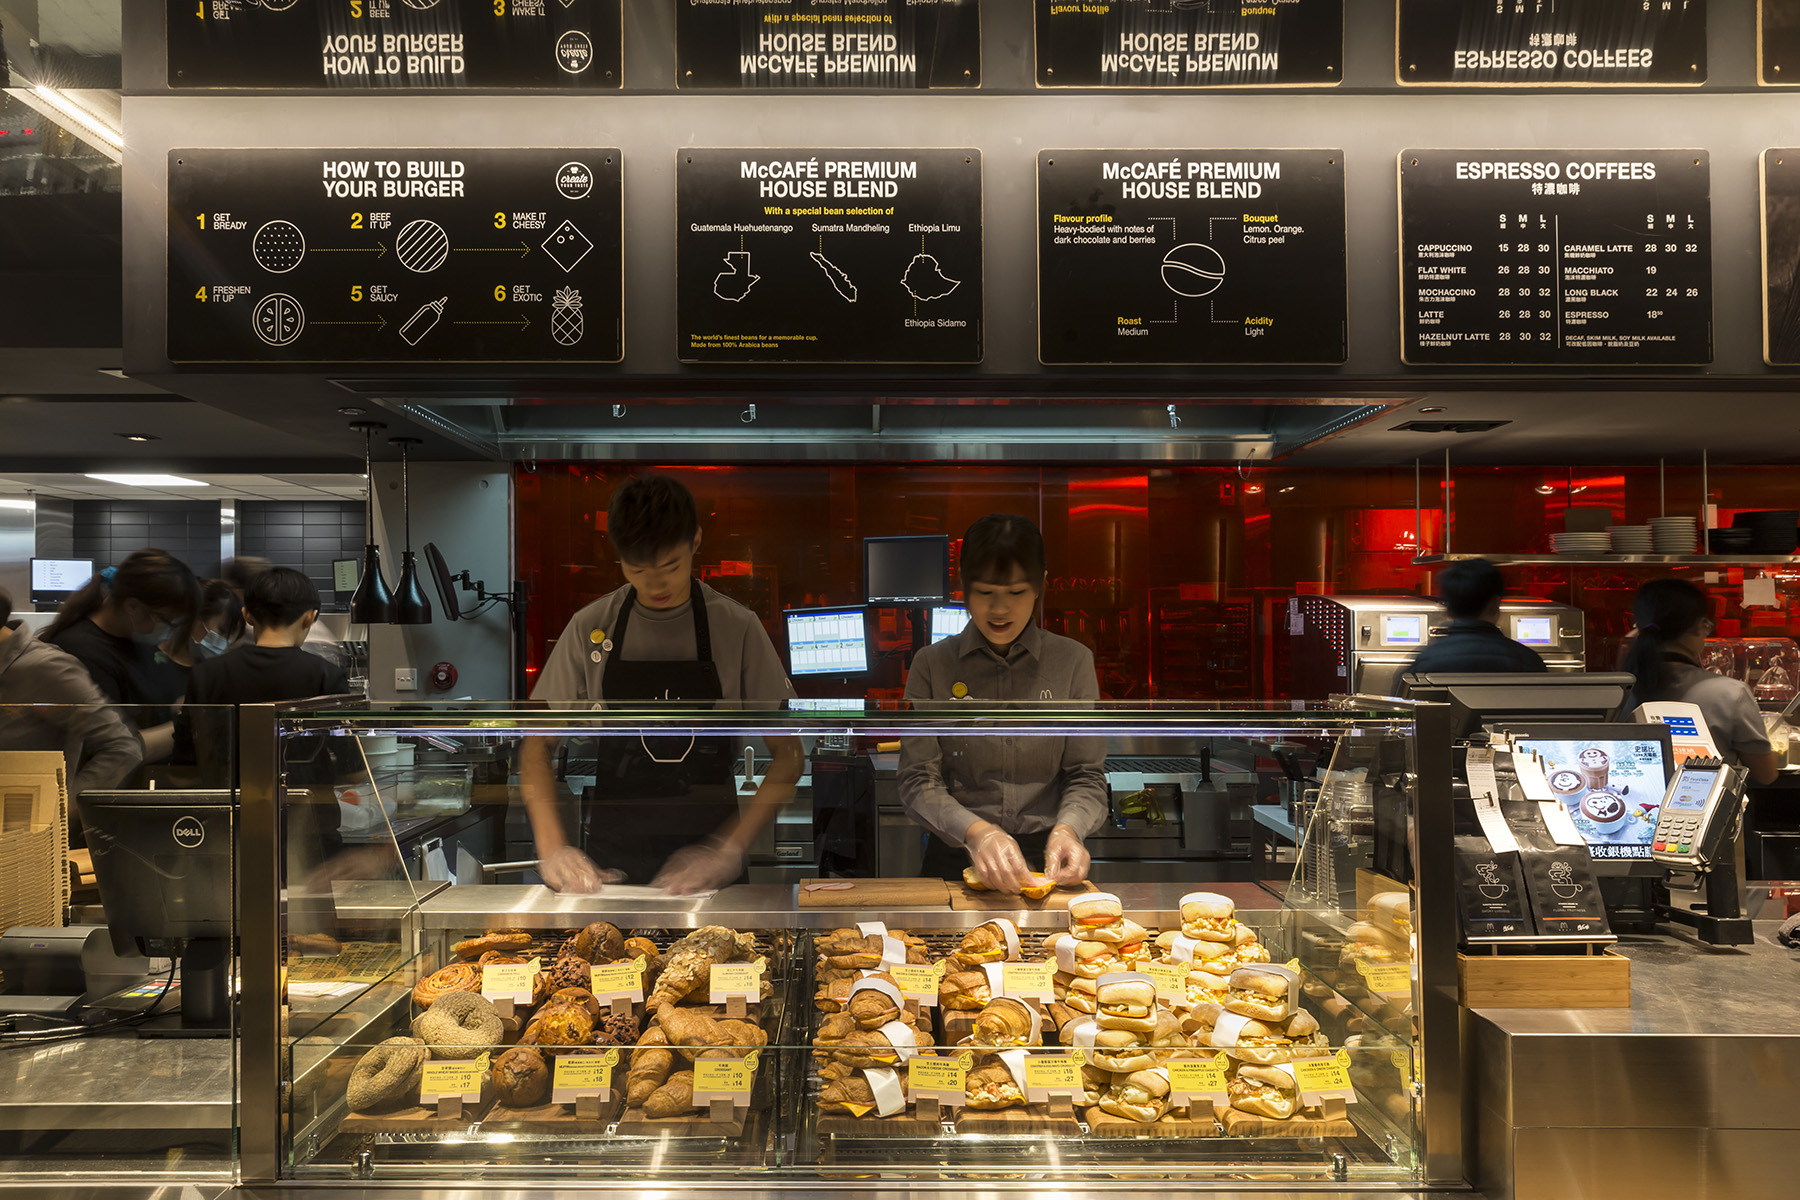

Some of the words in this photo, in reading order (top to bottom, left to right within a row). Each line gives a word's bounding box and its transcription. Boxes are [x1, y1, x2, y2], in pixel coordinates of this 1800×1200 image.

[323, 161, 369, 178] HOW
[374, 161, 400, 178] TO
[407, 161, 464, 178] BUILD
[741, 157, 818, 178] McCAFÉ
[825, 161, 916, 178] PREMIUM
[1103, 158, 1181, 179] McCAFÉ
[1187, 162, 1280, 179] PREMIUM
[1456, 162, 1560, 179] ESPRESSO
[1566, 162, 1656, 180] COFFEES
[560, 173, 588, 183] create
[322, 180, 377, 197] YOUR
[383, 180, 464, 197] BURGER
[760, 180, 827, 197] HOUSE
[833, 181, 898, 197] BLEND
[1122, 181, 1190, 198] HOUSE
[1196, 181, 1261, 198] BLEND
[1531, 182, 1580, 195] 特濃咖啡
[764, 206, 783, 214] With
[792, 207, 821, 216] special
[823, 207, 844, 215] bean
[846, 207, 883, 215] selection
[885, 207, 894, 215] of
[351, 212, 362, 228] 2
[370, 212, 390, 220] BEEF
[494, 212, 506, 228] 3
[513, 212, 536, 220] MAKE
[539, 212, 546, 220] IT
[1054, 214, 1084, 222] Flavour
[1086, 214, 1112, 224] profile
[1243, 214, 1278, 224] Bouquet
[1499, 214, 1506, 222] S
[1518, 214, 1527, 222] M
[1540, 214, 1546, 222] L
[1647, 214, 1654, 222] S
[1666, 214, 1675, 222] M
[1687, 214, 1694, 222] L
[196, 213, 204, 229] 1
[213, 220, 247, 229] BREADY
[370, 220, 377, 229] IT
[379, 220, 391, 229] UP
[512, 220, 545, 229] CHEESY
[690, 223, 731, 231] Guatemala
[733, 223, 793, 233] Huehuetenango
[812, 223, 844, 232] Sumatra
[846, 224, 889, 233] Mandheling
[908, 223, 940, 233] Ethiopia
[942, 224, 960, 232] Limu
[1054, 225, 1105, 235] Heavy-bodied
[1124, 225, 1145, 233] notes
[1146, 224, 1154, 233] of
[1243, 225, 1271, 233] Lemon.
[1274, 224, 1304, 234] Orange.
[1054, 236, 1071, 244] dark
[1073, 236, 1110, 244] chocolate
[1112, 235, 1127, 243] and
[1129, 235, 1156, 243] berries
[1243, 235, 1266, 243] Citrus
[1268, 235, 1284, 245] peel
[1417, 244, 1472, 252] CAPPUCCINO
[1498, 243, 1508, 252] 15
[1517, 243, 1529, 252] 28
[1538, 244, 1549, 252] 30
[1645, 244, 1657, 252] 28
[1665, 244, 1676, 252] 30
[1685, 244, 1697, 252] 32
[1498, 266, 1509, 274] 26
[1518, 265, 1530, 274] 28
[1538, 266, 1550, 274] 30
[1646, 266, 1656, 274] 19
[351, 285, 362, 301] 5
[370, 285, 387, 293] GET
[494, 285, 506, 301] 6
[512, 285, 530, 293] GET
[1498, 288, 1510, 296] 28
[1518, 288, 1530, 296] 30
[1539, 288, 1550, 296] 32
[1646, 288, 1657, 296] 22
[1666, 288, 1677, 296] 24
[1686, 288, 1698, 296] 26
[195, 286, 207, 302] 4
[213, 293, 220, 302] IT
[222, 293, 234, 302] UP
[370, 293, 398, 302] SAUCY
[513, 293, 542, 301] EXOTIC
[1499, 310, 1510, 318] 26
[1519, 310, 1530, 318] 28
[1539, 310, 1551, 318] 30
[904, 319, 935, 328] Ethiopia
[937, 318, 966, 327] Sidamo
[1117, 317, 1141, 325] Roast
[1245, 317, 1273, 326] Acidity
[1118, 327, 1148, 335] Medium
[1245, 327, 1264, 337] Light
[1499, 332, 1510, 340] 28
[1519, 332, 1531, 340] 30
[1539, 332, 1551, 340] 32
[176, 828, 201, 836] DELL
